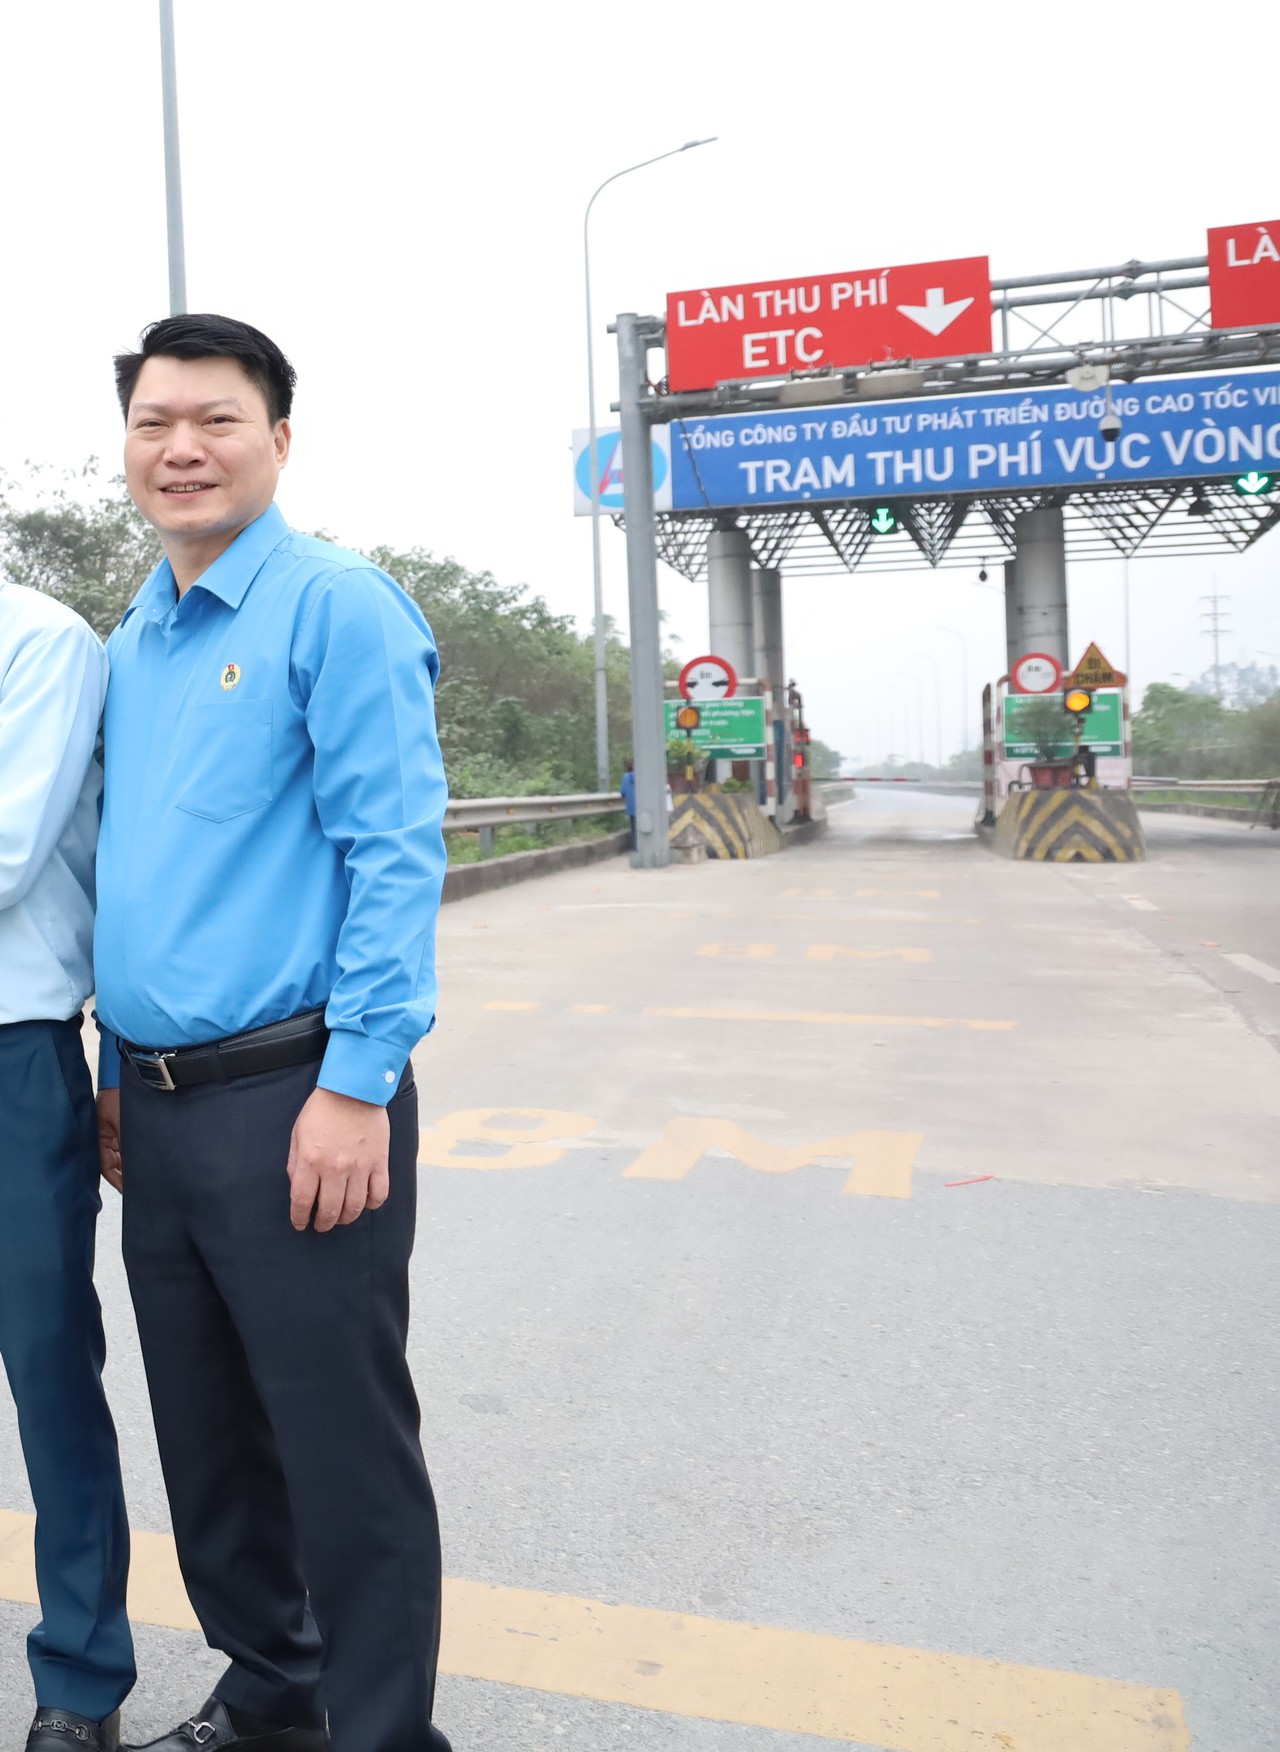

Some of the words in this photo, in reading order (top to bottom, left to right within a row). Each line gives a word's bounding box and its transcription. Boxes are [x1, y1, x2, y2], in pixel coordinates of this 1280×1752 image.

[677, 290, 744, 327] LÀN
[752, 285, 821, 319] THU
[830, 269, 891, 310] PHÍ
[742, 326, 824, 369] ETC
[679, 424, 735, 450] TỔNG
[739, 424, 797, 446] CÔNG
[801, 422, 828, 441] TY
[832, 412, 878, 439] ĐẦU
[882, 413, 912, 435] TƯ
[916, 406, 978, 432] PHÁT
[982, 398, 1050, 427] TRIỂN
[1054, 395, 1141, 422] ĐƯỜNG
[1145, 393, 1195, 415] CAO
[1199, 382, 1250, 411] TỐC
[1252, 383, 1280, 407] VI
[738, 453, 856, 499] TRẠM
[866, 446, 955, 486] THU
[969, 429, 1043, 480] PHÍ
